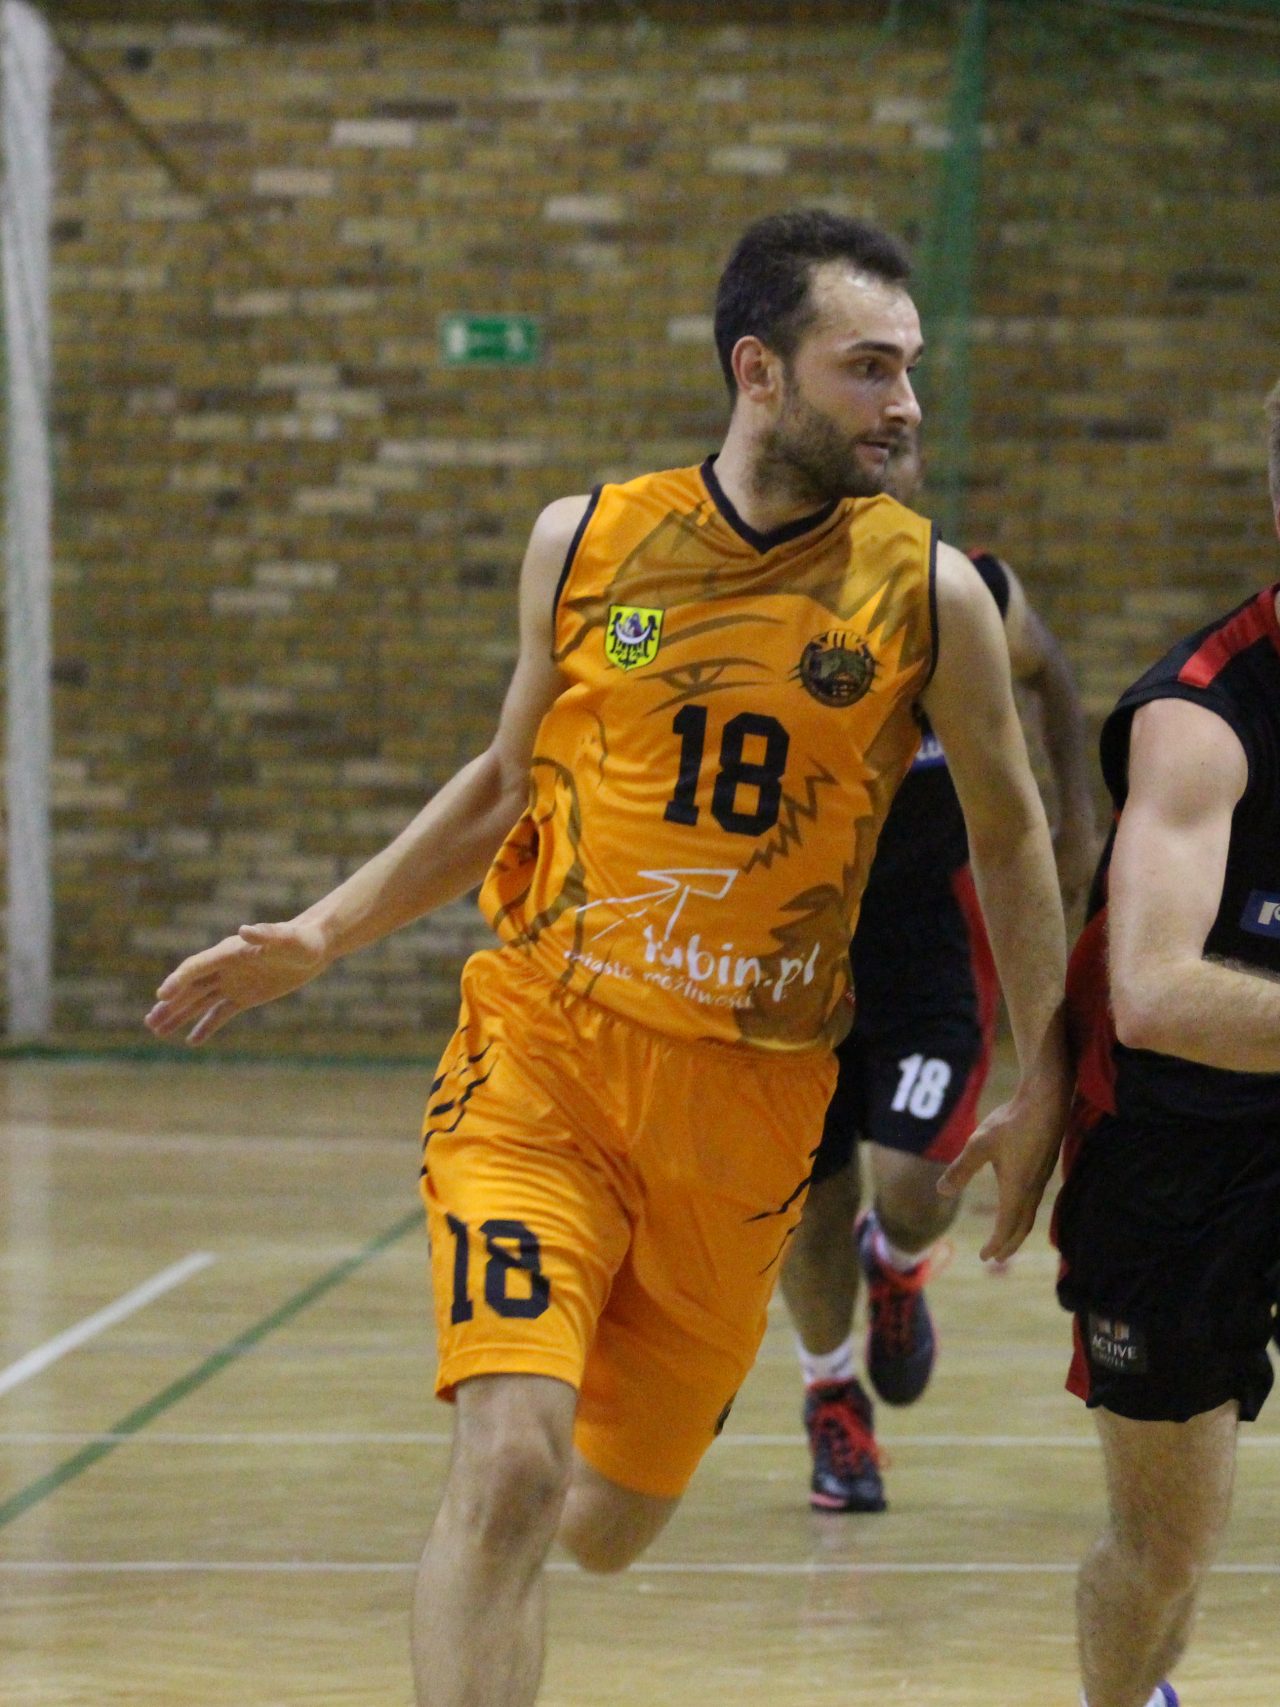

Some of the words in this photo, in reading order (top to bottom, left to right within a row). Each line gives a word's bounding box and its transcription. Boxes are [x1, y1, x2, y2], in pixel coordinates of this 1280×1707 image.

[663, 704, 790, 837] 18
[890, 1053, 952, 1120] 18
[445, 1212, 551, 1326] 18
